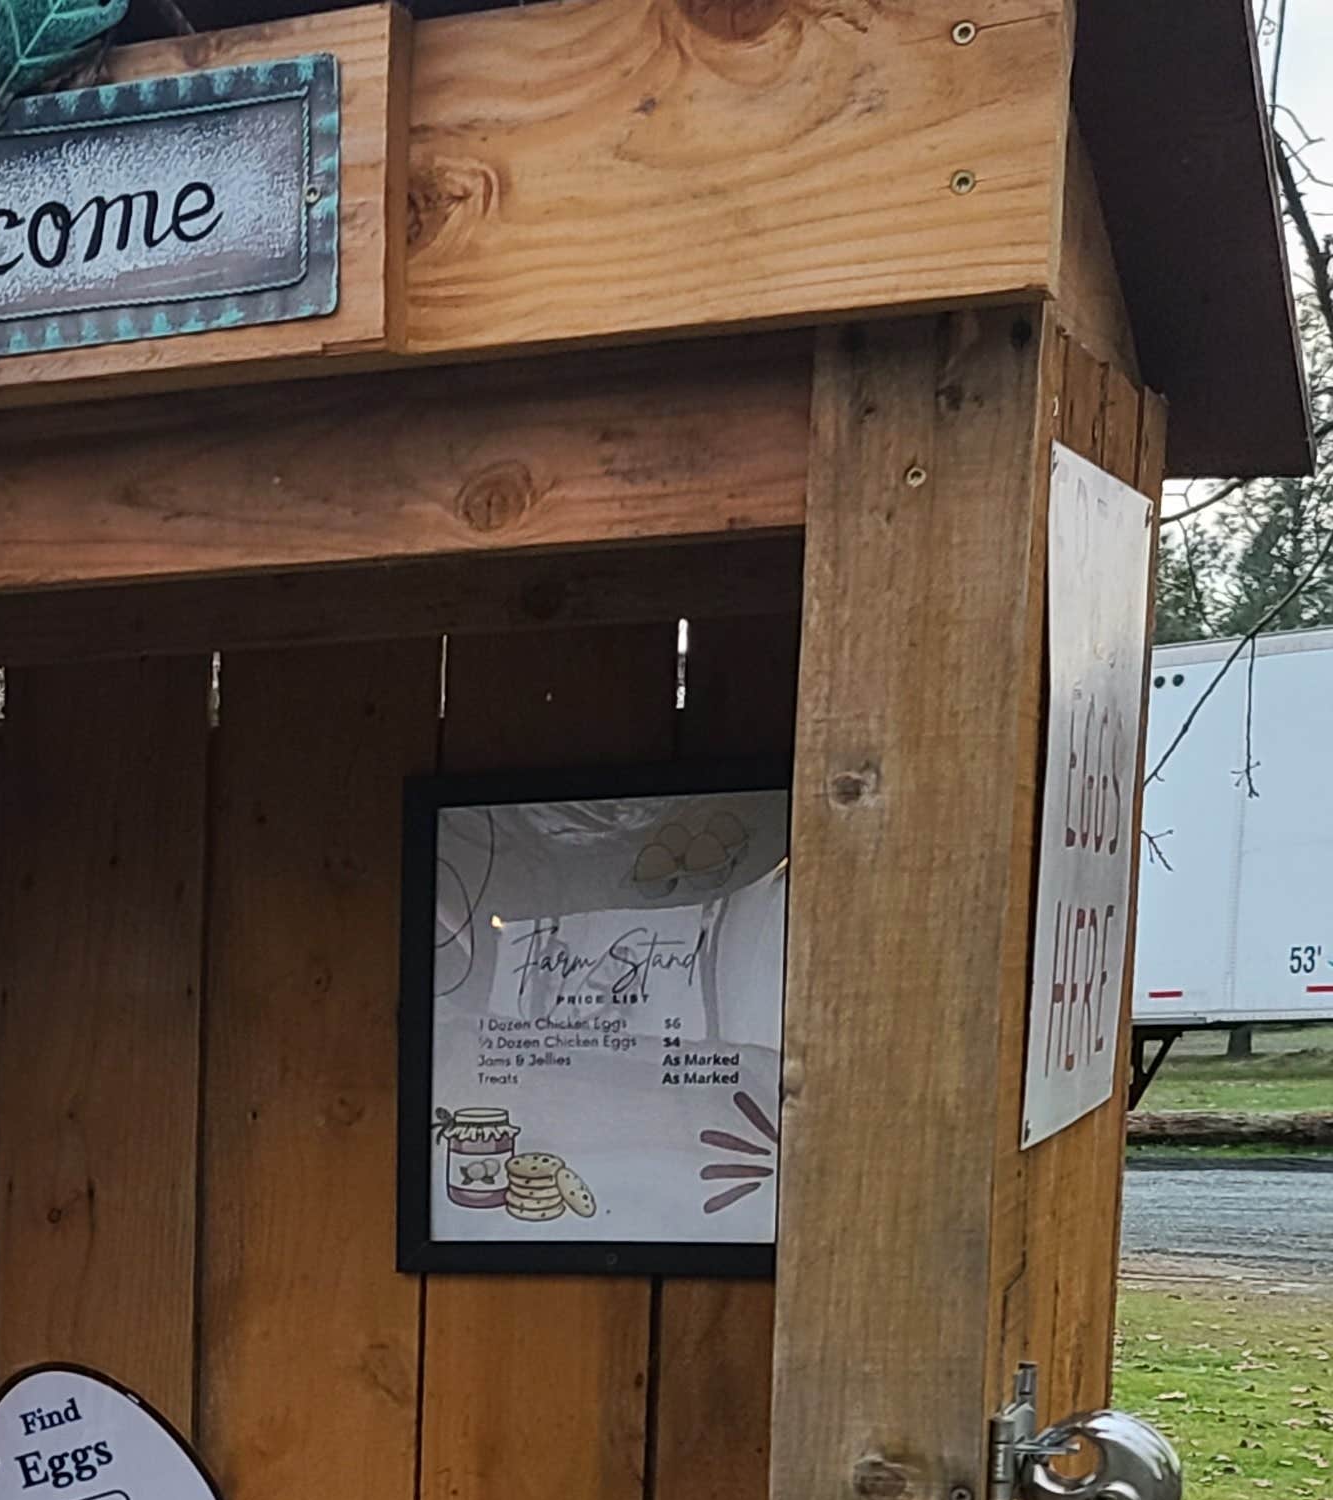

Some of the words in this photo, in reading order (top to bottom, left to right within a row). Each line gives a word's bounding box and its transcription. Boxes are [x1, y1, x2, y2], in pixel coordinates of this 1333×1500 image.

[1064, 692, 1123, 856] EGGS
[511, 925, 597, 996] Farm
[608, 926, 707, 996] Stand
[1045, 901, 1115, 1078] HERE
[555, 994, 605, 1005] PRICE
[612, 994, 651, 1005] LIST
[488, 1019, 531, 1031] Dozen
[535, 1017, 590, 1031] Chicken
[593, 1017, 627, 1033] Eggs
[497, 1036, 540, 1049] Dozen
[544, 1035, 599, 1048] Chicken
[603, 1035, 638, 1051] Eggs
[477, 1054, 511, 1067] Jams
[515, 1054, 525, 1067] &
[528, 1052, 572, 1067] Jellies
[661, 1054, 681, 1067] As
[683, 1053, 741, 1067] Marked
[477, 1072, 519, 1085] Treats
[661, 1073, 681, 1086] As
[683, 1072, 740, 1086] Marked
[19, 1397, 82, 1436] Find
[15, 1439, 113, 1489] Eggs
